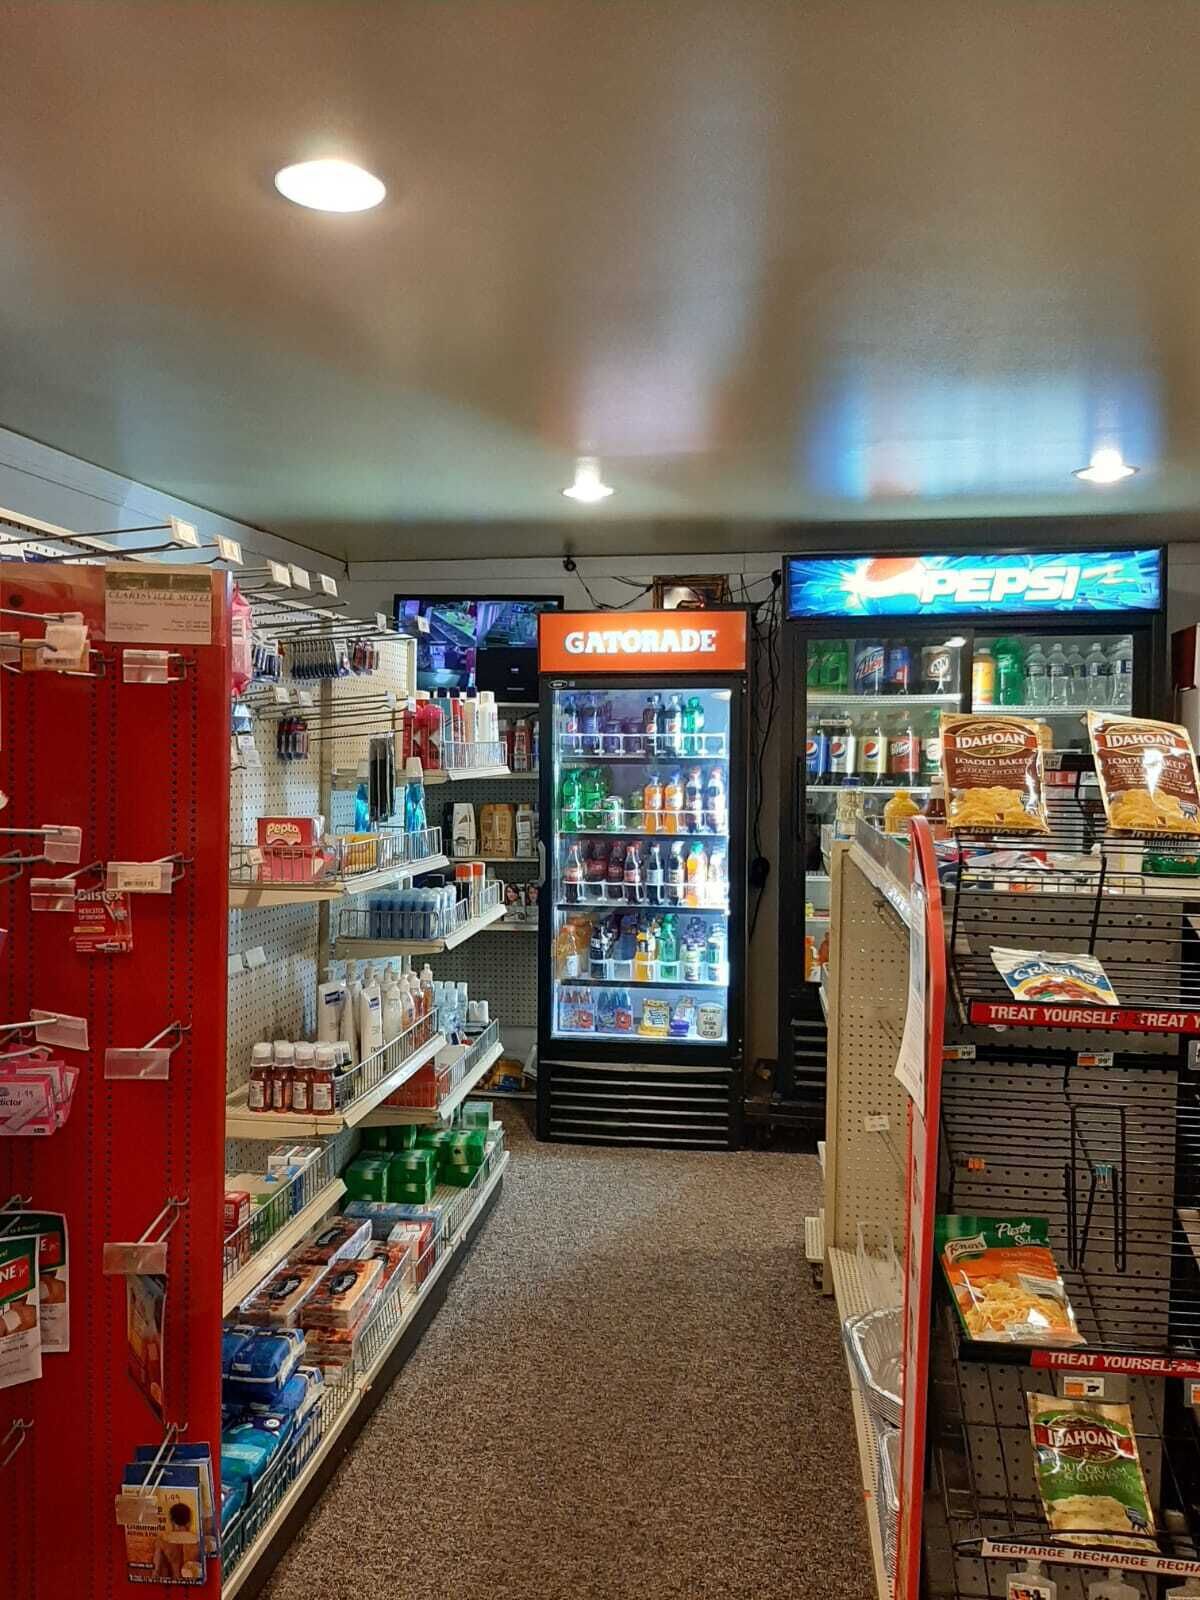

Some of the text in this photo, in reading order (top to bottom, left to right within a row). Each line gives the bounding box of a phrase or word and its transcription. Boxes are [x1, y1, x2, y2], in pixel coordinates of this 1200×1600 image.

[920, 566, 1082, 603] PEPSI
[564, 629, 717, 655] GATORADE
[956, 732, 1025, 749] IDAHOAN
[1105, 734, 1176, 748] IDAHOAN
[955, 757, 996, 766] LOADED
[990, 1005, 1037, 1021] TREAT
[1043, 1008, 1120, 1025] YOURSELF
[995, 1221, 1032, 1239] Pasta
[1050, 1352, 1097, 1366] TREAT
[1047, 1429, 1117, 1448] IDAHOAN
[991, 1543, 1065, 1559] RECHARGE
[1072, 1550, 1149, 1567] RECHARGE
